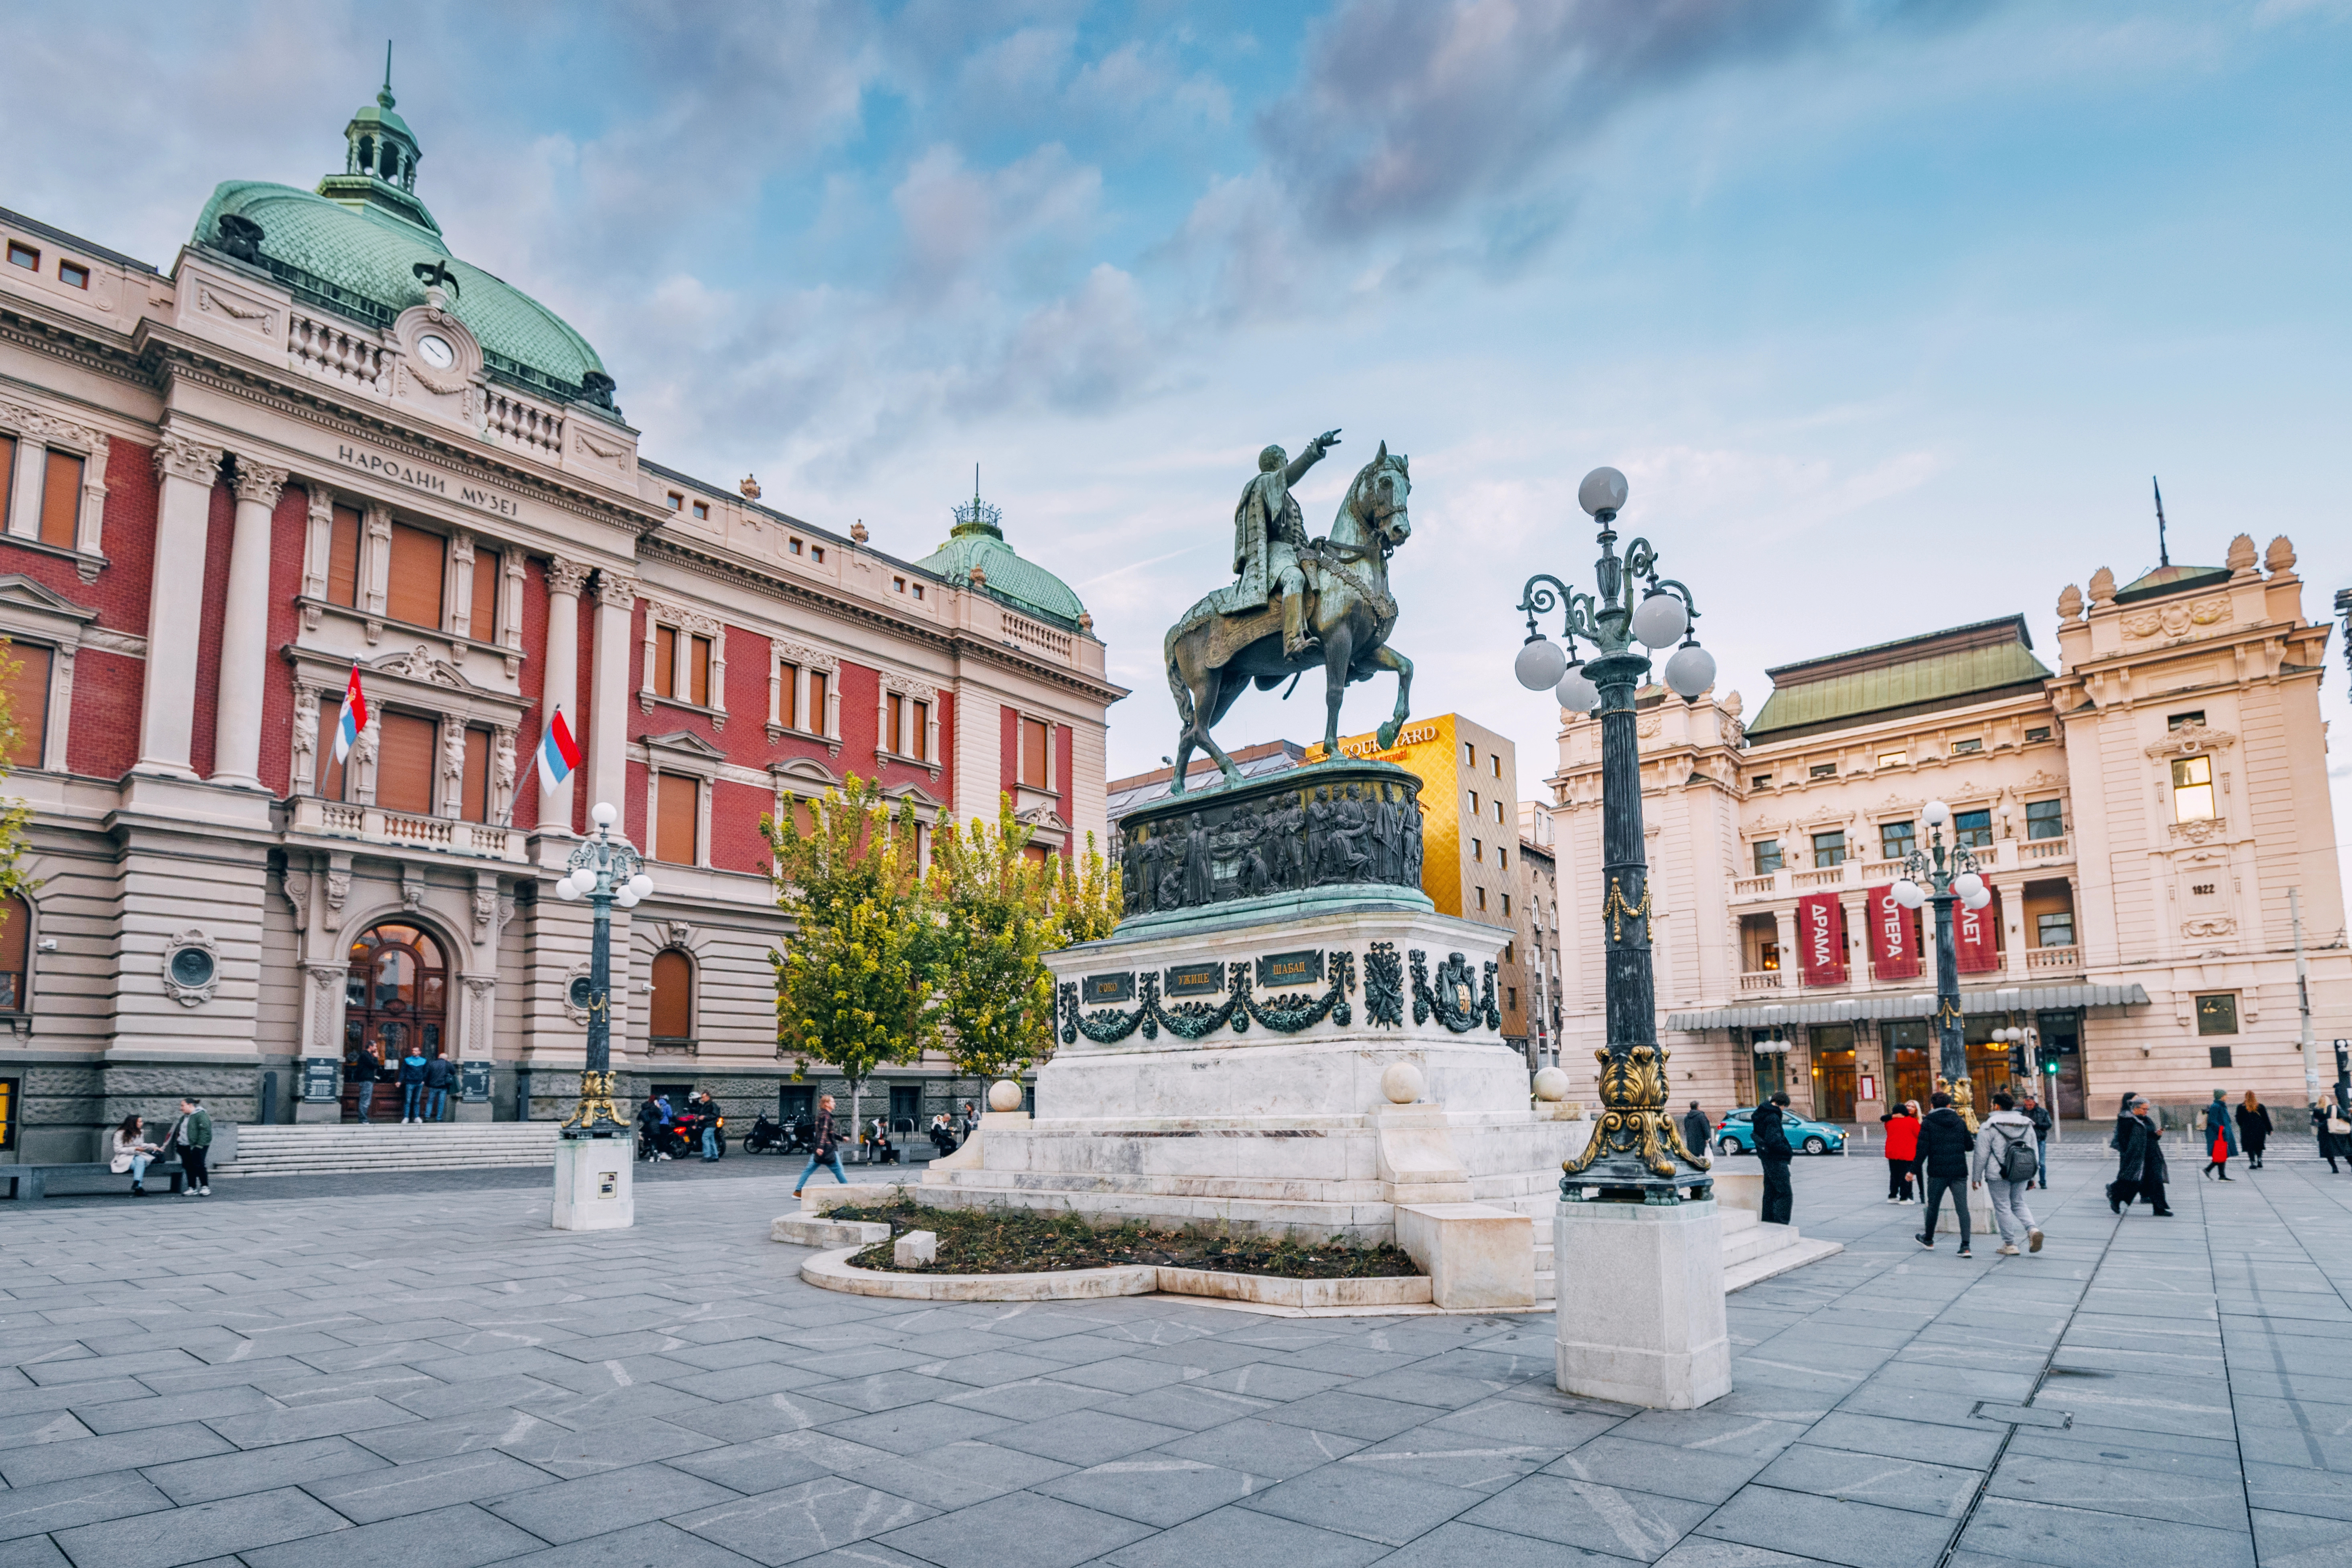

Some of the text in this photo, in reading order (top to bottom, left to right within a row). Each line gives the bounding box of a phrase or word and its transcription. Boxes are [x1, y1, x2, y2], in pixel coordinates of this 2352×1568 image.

[339, 445, 517, 516] НАРОДНИ МУЗЕЈ
[1341, 726, 1436, 759] COURYARD
[2192, 884, 2215, 895] 1922
[1812, 904, 1831, 966] ДРАМА
[1882, 895, 1903, 958] ОПЕРА
[1961, 899, 1981, 946] ЛЕТ
[1178, 972, 1209, 985] УЖИЦЕ
[1273, 961, 1306, 975] ШАБАЦ
[1098, 982, 1117, 993] СОКО
